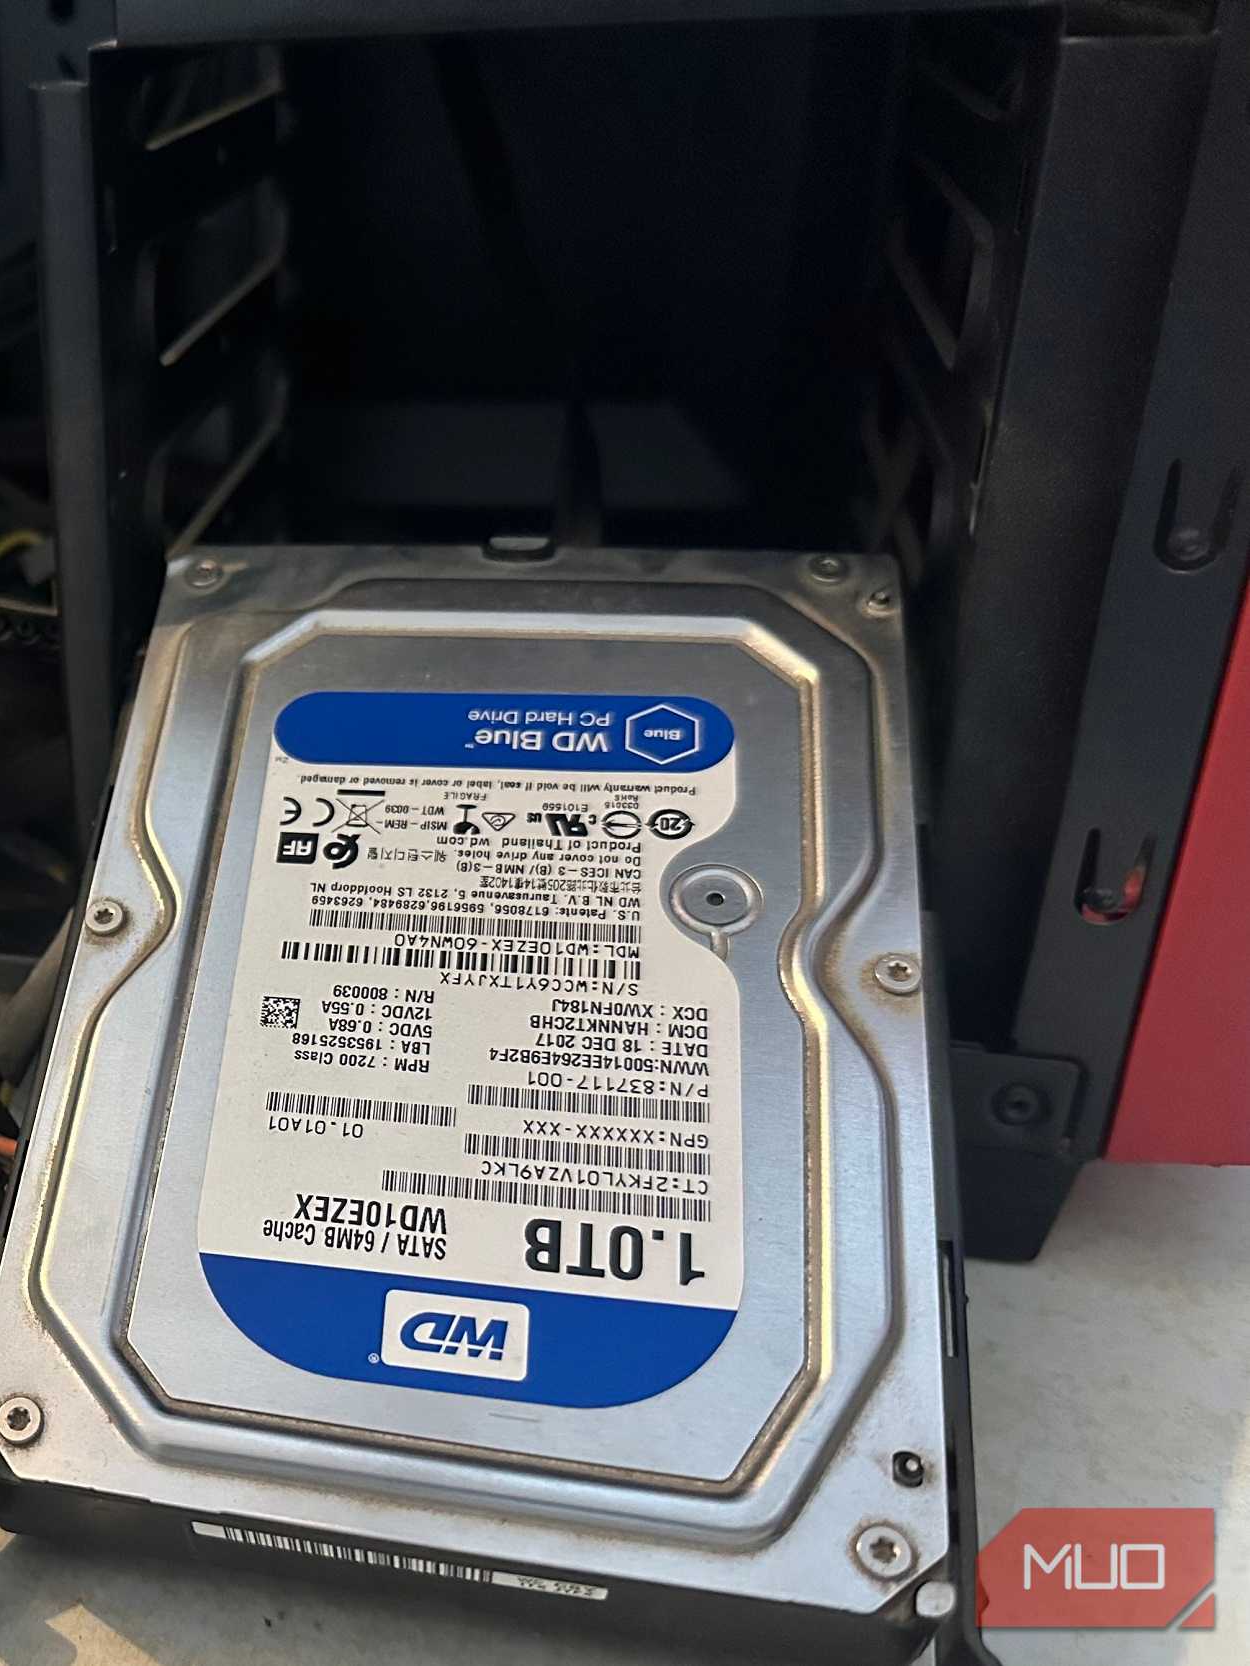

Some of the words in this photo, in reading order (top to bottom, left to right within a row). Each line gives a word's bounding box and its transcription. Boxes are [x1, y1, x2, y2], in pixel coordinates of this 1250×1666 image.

[467, 710, 518, 724] Drive
[525, 711, 573, 725] Hard
[580, 712, 610, 727] PC
[643, 729, 681, 741] Blue
[551, 732, 609, 753] WD
[363, 777, 406, 786] removed
[409, 779, 418, 787] is
[422, 779, 448, 787] cover
[467, 780, 492, 790] label
[525, 782, 532, 791] if
[537, 783, 558, 791] void
[562, 783, 575, 791] be
[581, 784, 600, 793] will
[603, 783, 650, 793] warranty
[443, 791, 487, 801] FRAGILE
[655, 785, 695, 796] Product
[437, 836, 490, 847] wd.com
[502, 838, 562, 851] Thailand
[567, 840, 581, 850] of
[587, 841, 641, 853] Product
[454, 849, 490, 860] holes.
[496, 851, 527, 862] drive
[532, 851, 554, 860] any
[559, 854, 594, 863] cover
[599, 855, 619, 865] not
[625, 856, 640, 867] Do
[615, 868, 641, 880] CAN
[309, 883, 326, 892] NL
[397, 887, 412, 897] LS
[418, 888, 448, 898] 2132
[471, 890, 557, 904] Taurusavenue
[564, 895, 589, 906] B.V.
[596, 896, 613, 906] NL
[619, 897, 640, 908] WD
[490, 903, 549, 916] 6178056,
[555, 907, 606, 919] Patents:
[613, 910, 640, 920] U.S.
[439, 972, 638, 996] S/N:WCC6Y1TXJYFX
[333, 984, 388, 1000] 800039
[405, 989, 434, 1003] R/N
[321, 1000, 364, 1016] 0.55A
[381, 1004, 432, 1019] 12VDC
[673, 1006, 707, 1021] DCX
[328, 1018, 371, 1033] 0.68A
[389, 1022, 432, 1037] 5VDC
[529, 1015, 648, 1035] HANNKT2CHB
[669, 1023, 707, 1039] DCM
[292, 1032, 382, 1050] 1953525168
[401, 1040, 430, 1054] LBA
[535, 1033, 574, 1049] 2017
[582, 1036, 615, 1051] DEC
[623, 1039, 641, 1053] 18
[662, 1041, 707, 1057] DATE
[294, 1049, 333, 1065] Class
[340, 1054, 375, 1068] 7200
[489, 1048, 709, 1076] WWN:50014EE264E9B2F4
[394, 1058, 429, 1073] RPM
[527, 1071, 708, 1097] P/N:837117-001
[523, 1120, 708, 1148] GPN:XXXXXX-XXX
[295, 1194, 446, 1234] WD10EZEX
[263, 1219, 315, 1246] Cache
[325, 1227, 374, 1251] 64MB
[397, 1234, 447, 1260] SATA
[524, 1218, 705, 1285] 1.0TB
[400, 1312, 508, 1362] WD
